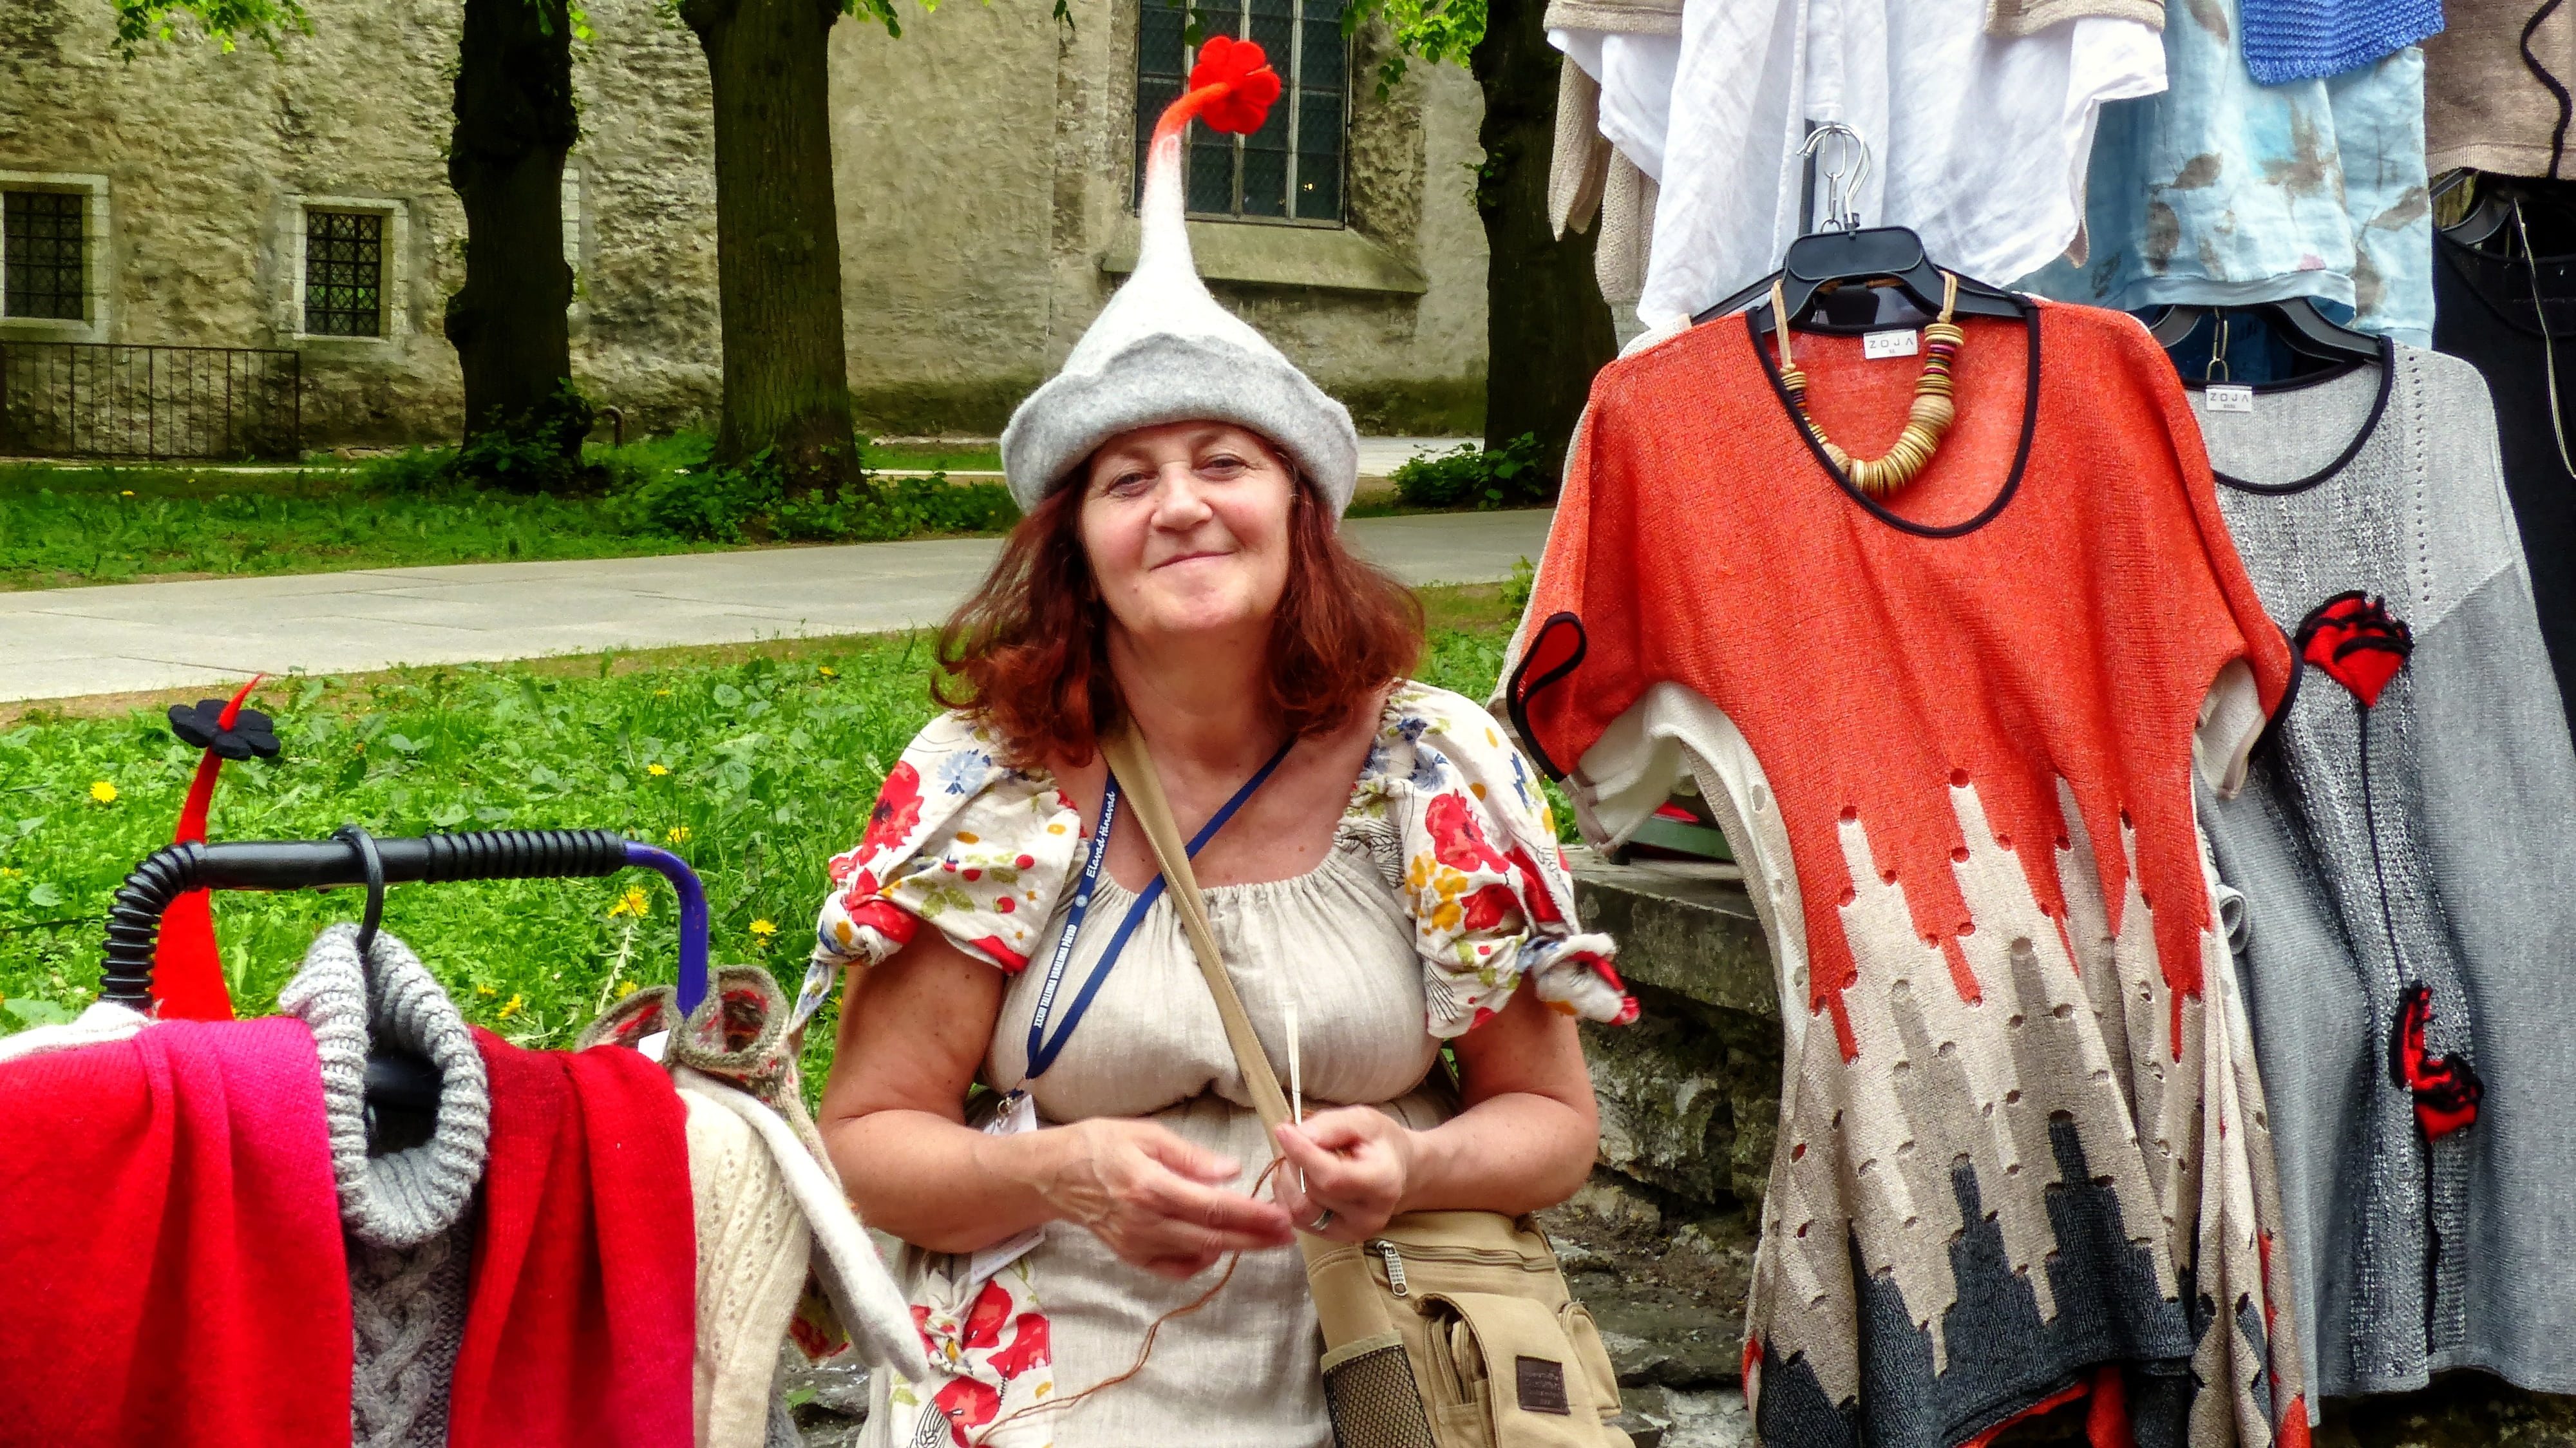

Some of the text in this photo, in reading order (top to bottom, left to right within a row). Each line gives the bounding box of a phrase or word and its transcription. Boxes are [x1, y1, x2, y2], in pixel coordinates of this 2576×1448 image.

[1869, 338, 1914, 349] ZOJA
[2210, 393, 2249, 403] ZOJA
[1086, 791, 1115, 878] Elavad tänavad
